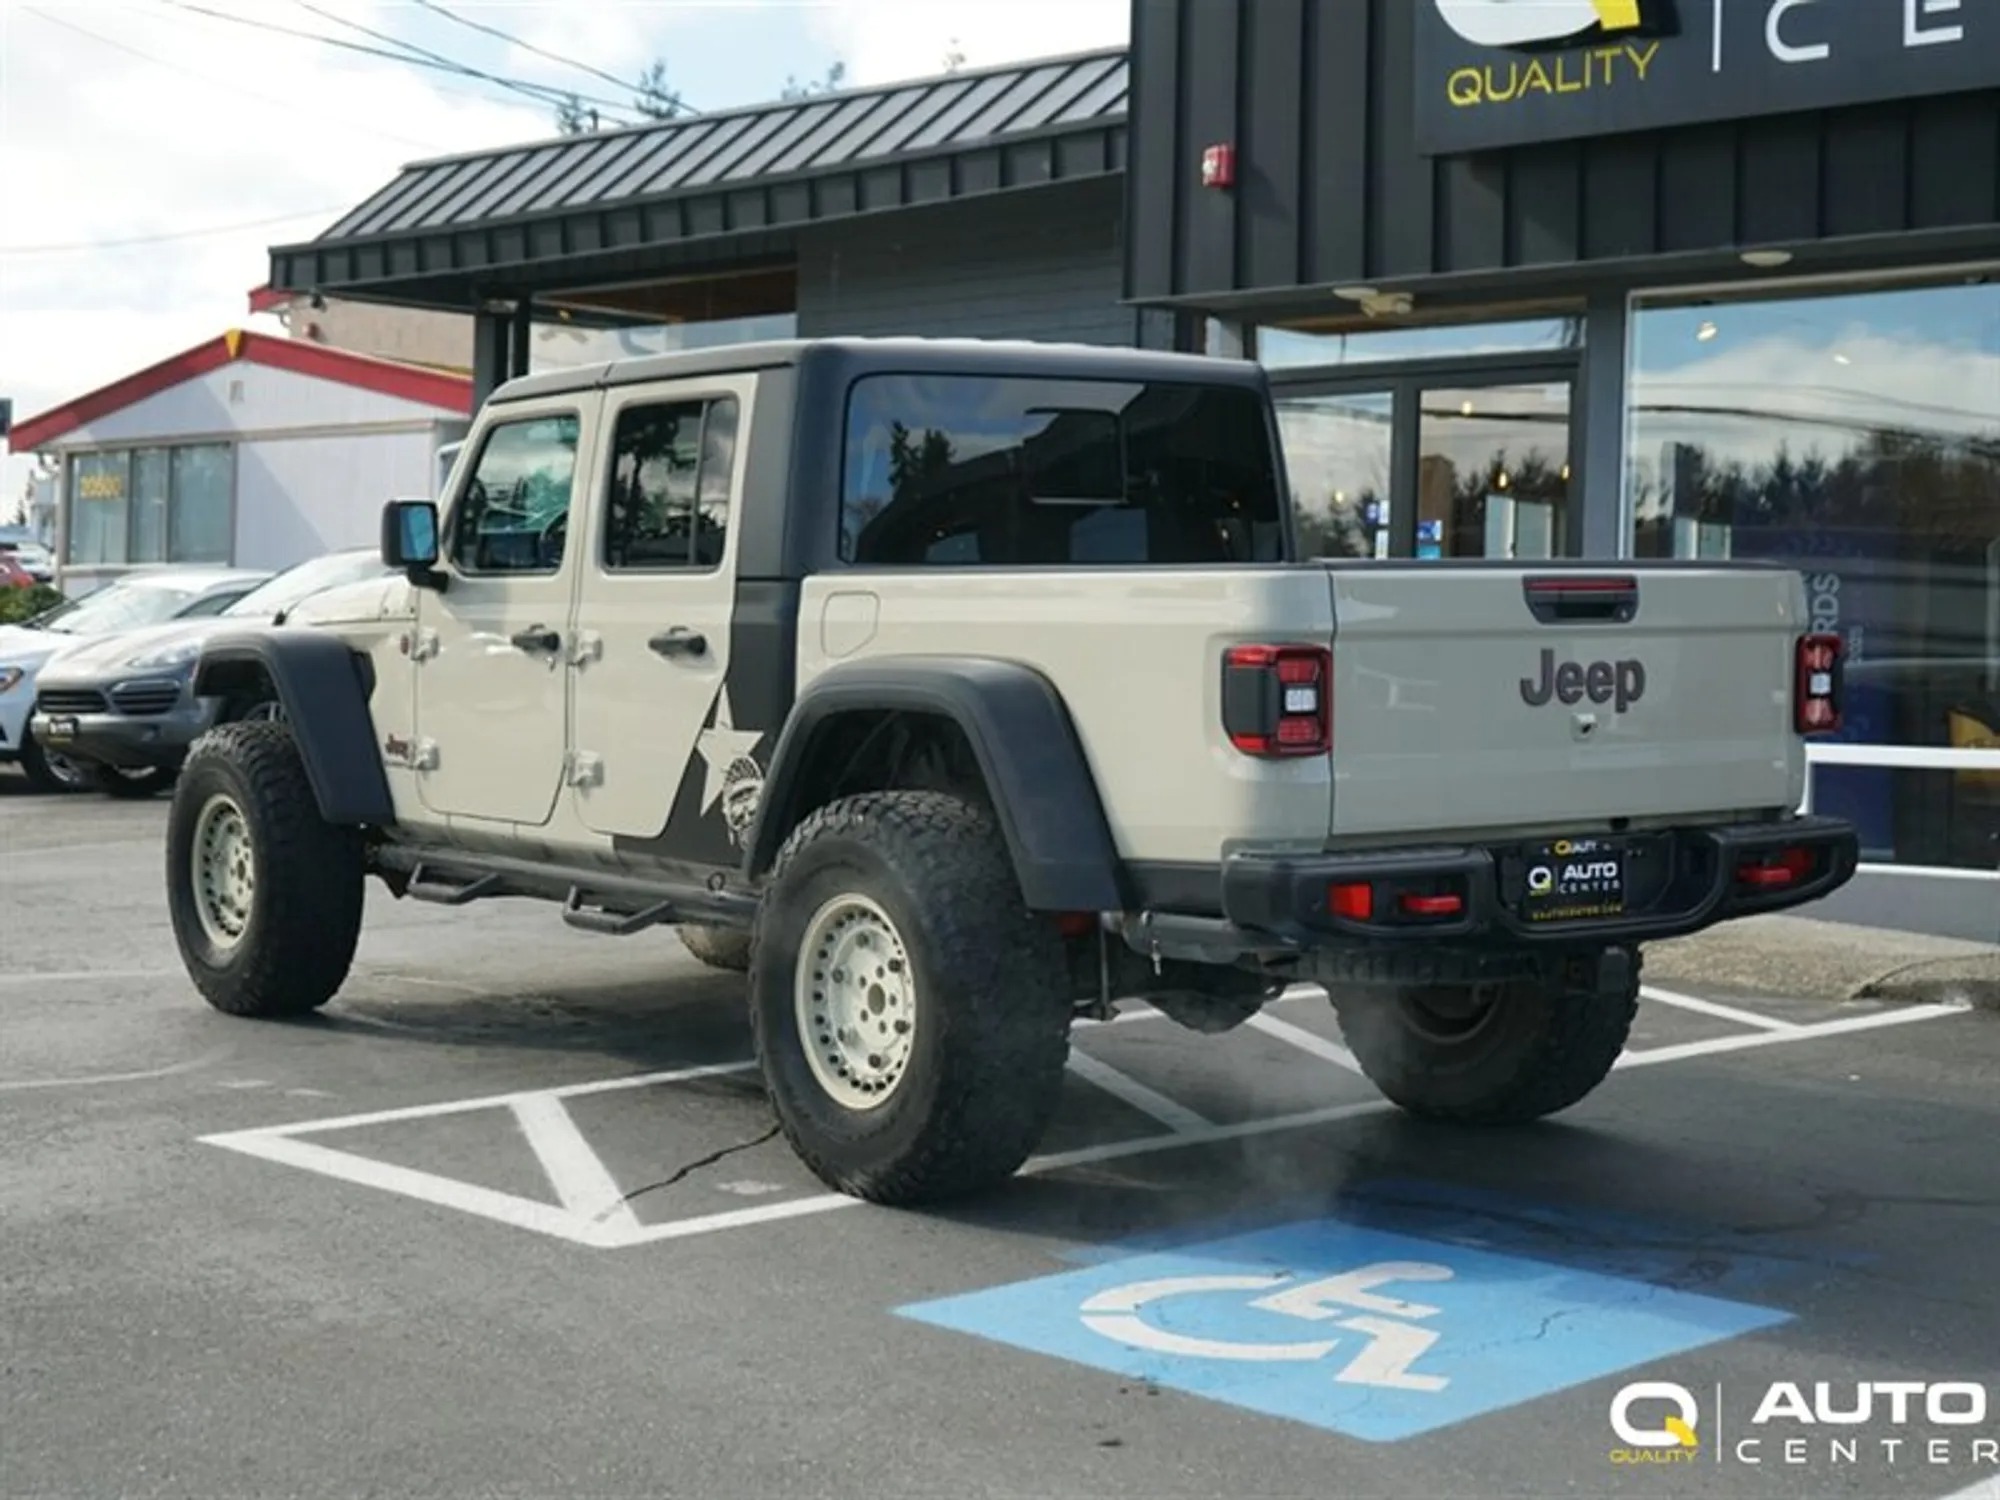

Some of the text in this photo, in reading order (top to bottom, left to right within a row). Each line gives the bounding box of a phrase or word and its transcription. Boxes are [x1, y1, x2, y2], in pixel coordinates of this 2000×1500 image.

[1447, 43, 1660, 107] QUALITY
[1519, 648, 1647, 714] Jeep
[1559, 880, 1620, 894] CENTER
[1563, 860, 1619, 881] AUTO
